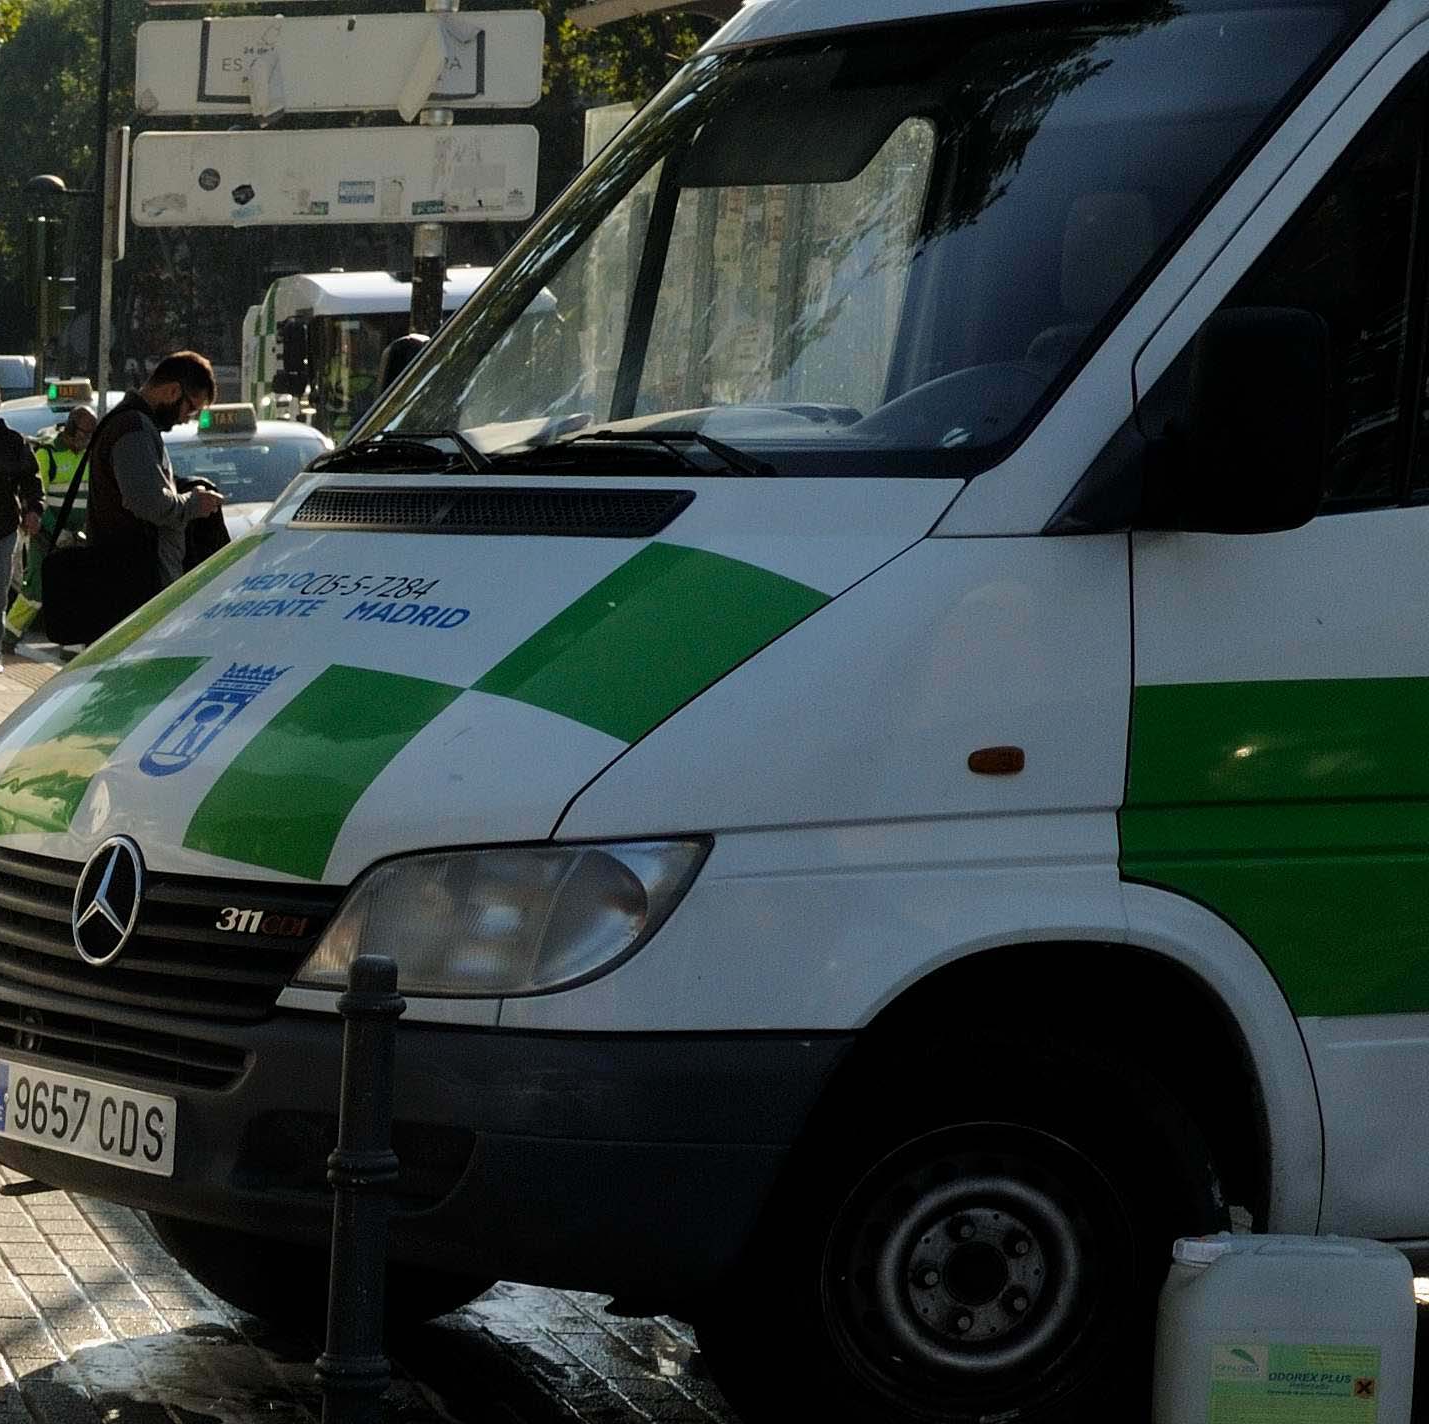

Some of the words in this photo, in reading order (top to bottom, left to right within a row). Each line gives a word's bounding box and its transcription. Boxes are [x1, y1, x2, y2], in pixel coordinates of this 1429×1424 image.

[221, 57, 244, 72] ES
[235, 571, 317, 592] MEDIO
[196, 599, 328, 620] AMBIENTE
[343, 600, 471, 629] MADRID
[14, 1076, 91, 1142] 9657
[98, 1096, 164, 1162] CDS
[1268, 1372, 1318, 1384] ODOREX
[1320, 1373, 1352, 1385] PLUS
